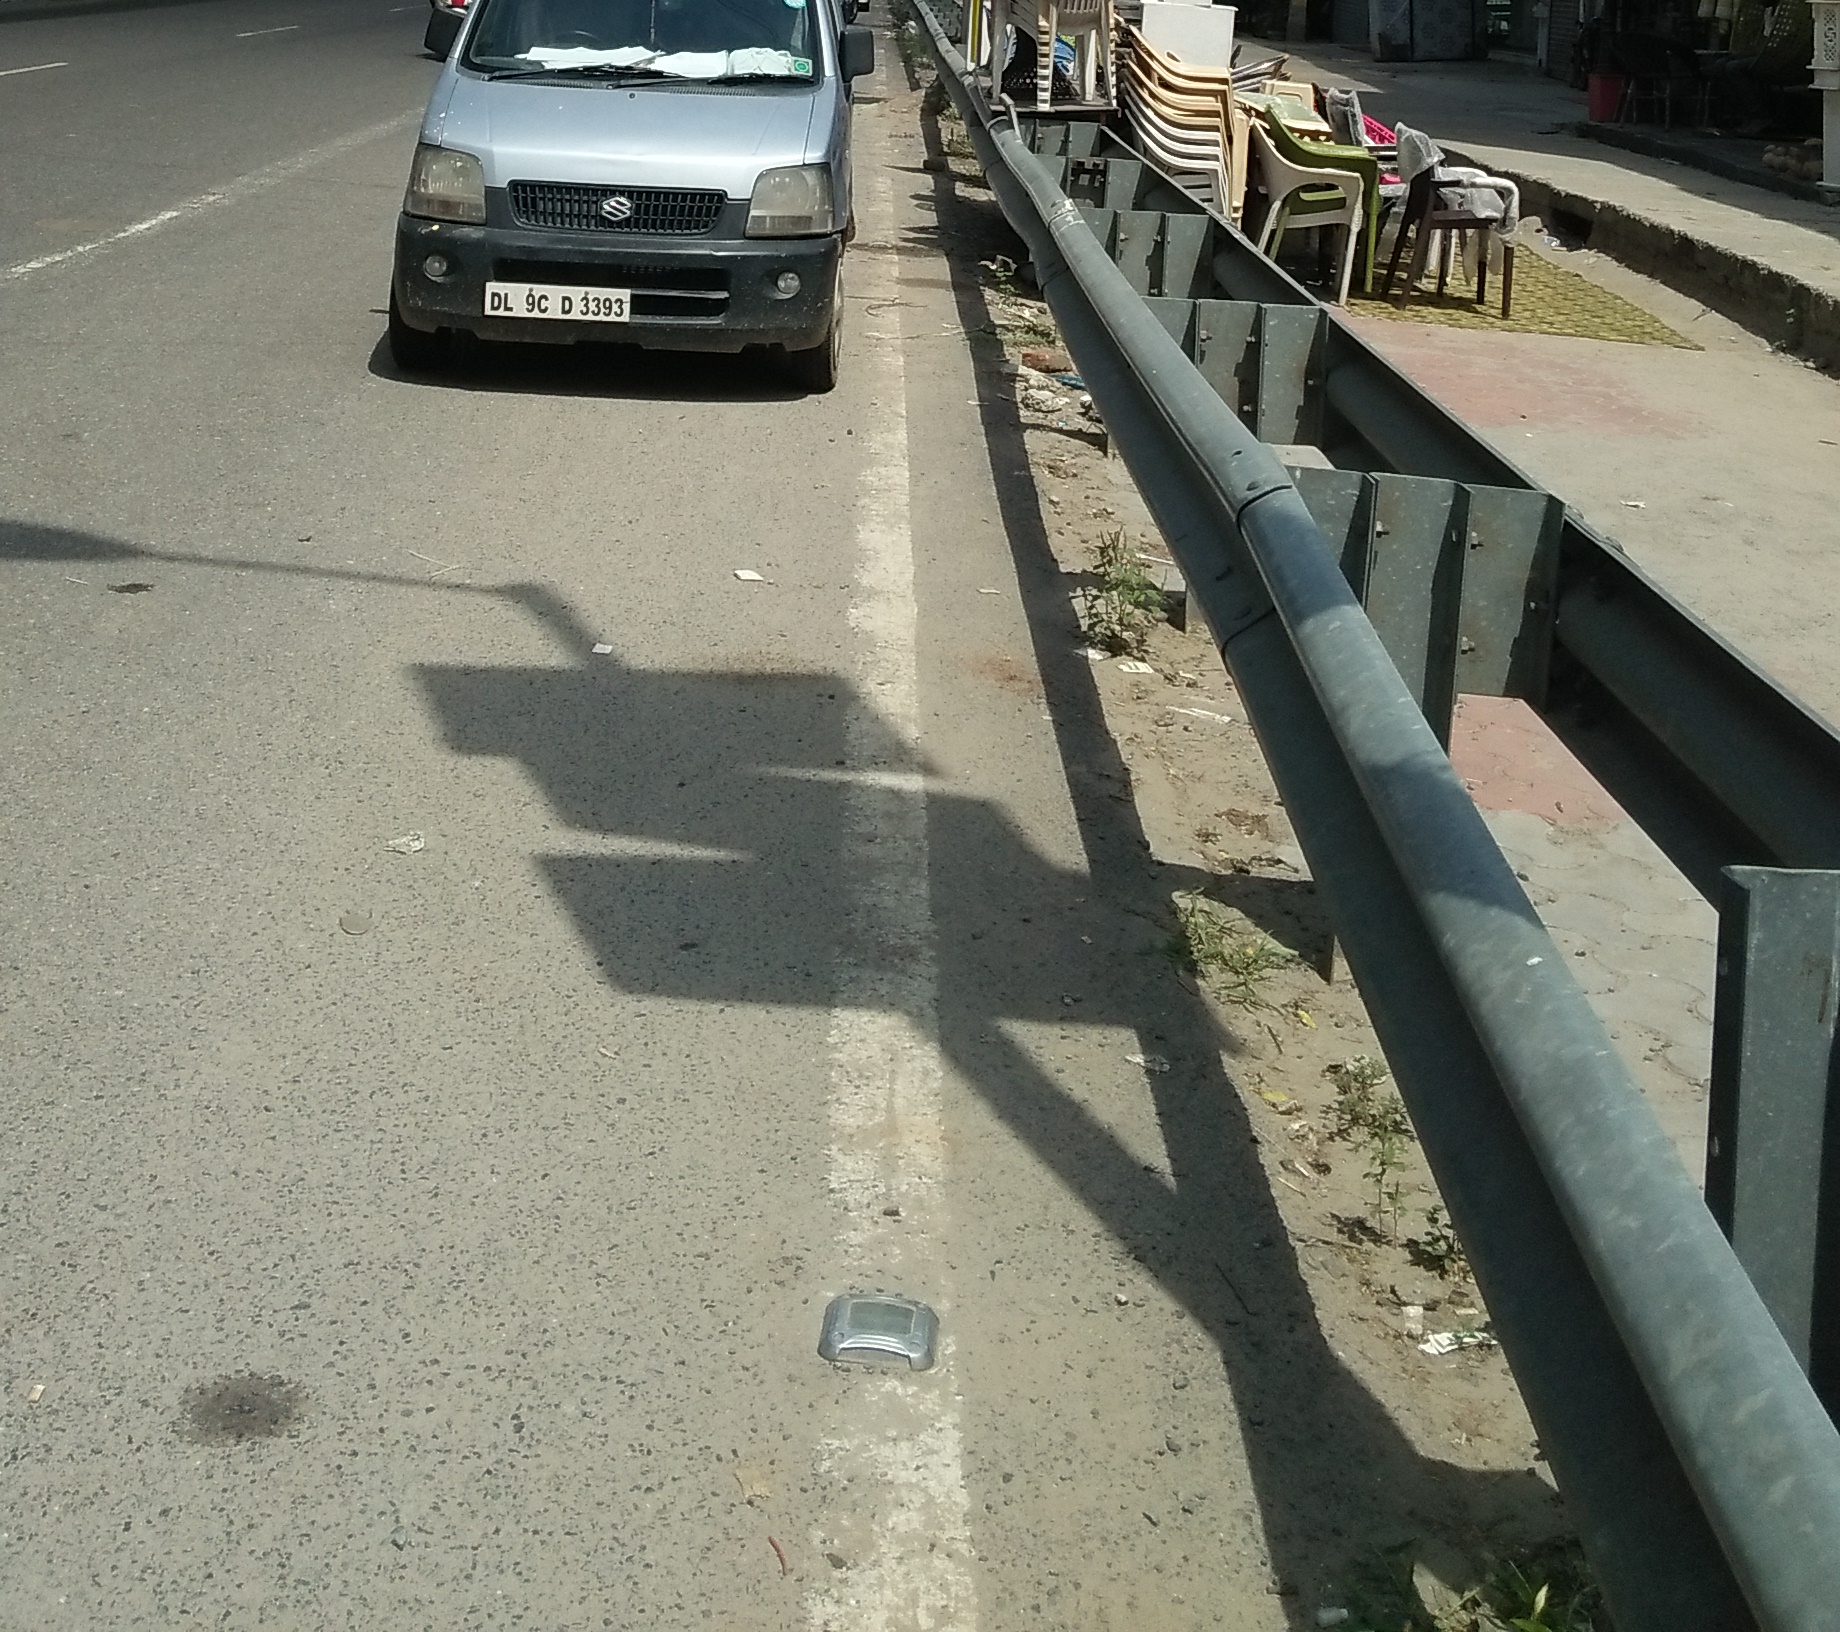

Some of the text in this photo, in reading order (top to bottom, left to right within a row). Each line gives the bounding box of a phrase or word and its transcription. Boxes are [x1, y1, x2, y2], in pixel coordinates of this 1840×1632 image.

[489, 290, 625, 318] DL 9C D 3393
